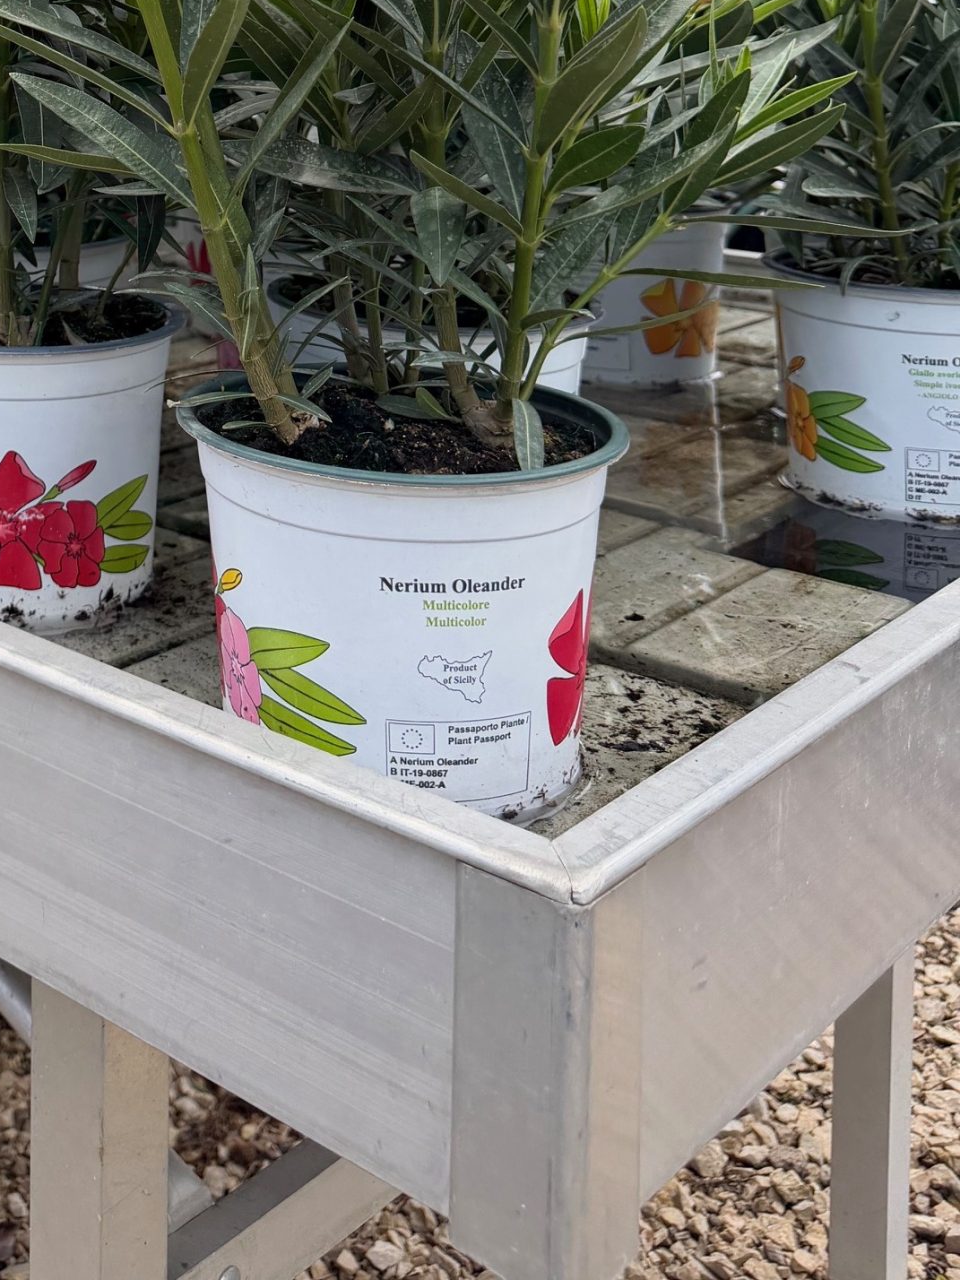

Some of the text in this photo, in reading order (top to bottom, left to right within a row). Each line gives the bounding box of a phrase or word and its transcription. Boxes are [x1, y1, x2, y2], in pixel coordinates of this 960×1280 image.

[901, 353, 949, 367] Nerium
[379, 576, 525, 593] Nerium Oleander
[422, 599, 490, 611] Multicolore
[426, 616, 487, 628] Multicolor
[443, 664, 477, 672] Product
[443, 675, 476, 685] of Sicily
[448, 722, 498, 734] Passaporto
[500, 717, 525, 729] Piante
[448, 732, 511, 745] Plant Passport
[390, 756, 478, 766] A Nerium Oleander
[390, 767, 448, 777] B IT-19-0867
